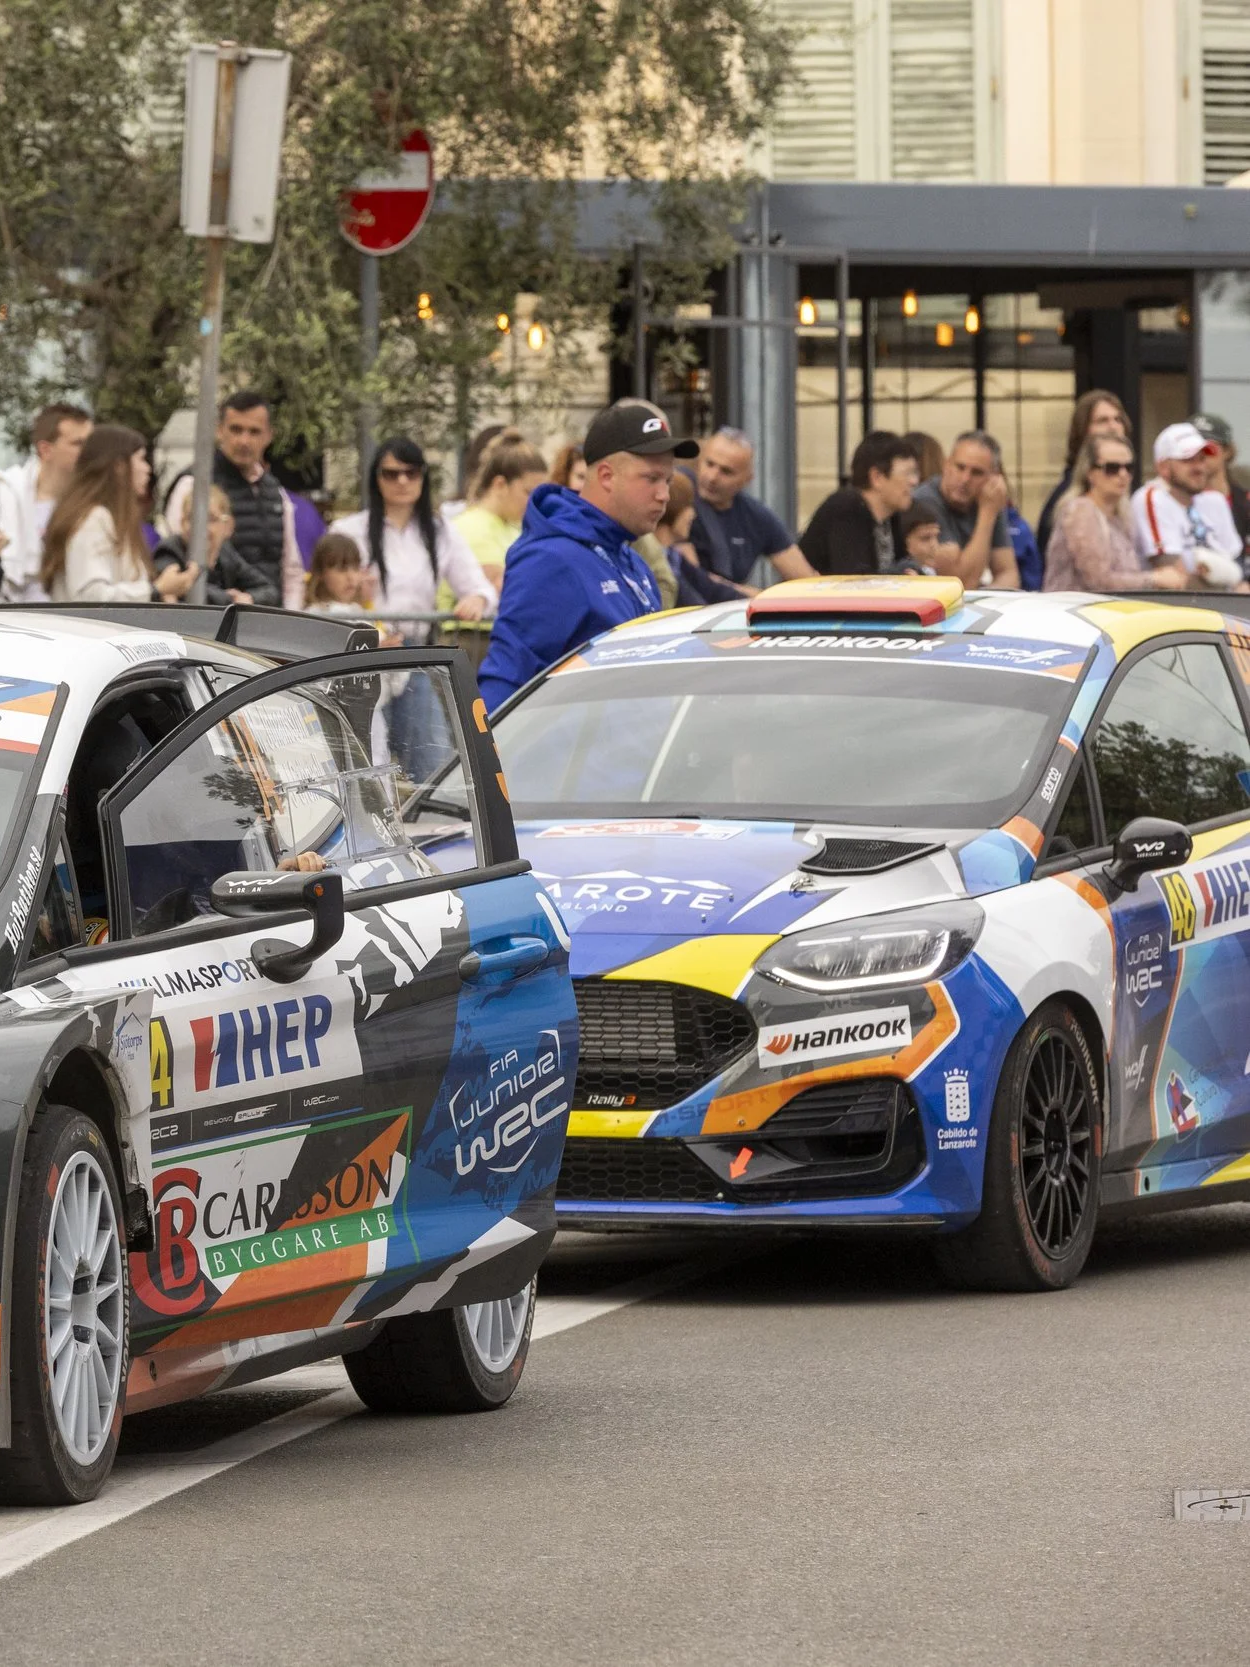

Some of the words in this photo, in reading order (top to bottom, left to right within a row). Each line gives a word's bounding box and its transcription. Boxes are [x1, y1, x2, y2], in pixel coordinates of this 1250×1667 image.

[545, 881, 724, 911] AROTE
[1162, 872, 1197, 942] 48
[149, 1019, 172, 1108] 4
[489, 1048, 519, 1079] FIA
[459, 1051, 556, 1128] JUNIOR
[587, 1094, 637, 1108] Rally3
[454, 1075, 569, 1176] WRC
[937, 1127, 967, 1139] Cabildo
[968, 1126, 978, 1137] de
[938, 1138, 977, 1150] Lanzarote
[213, 1223, 343, 1273] BYGGARE
[359, 1211, 390, 1239] AB
